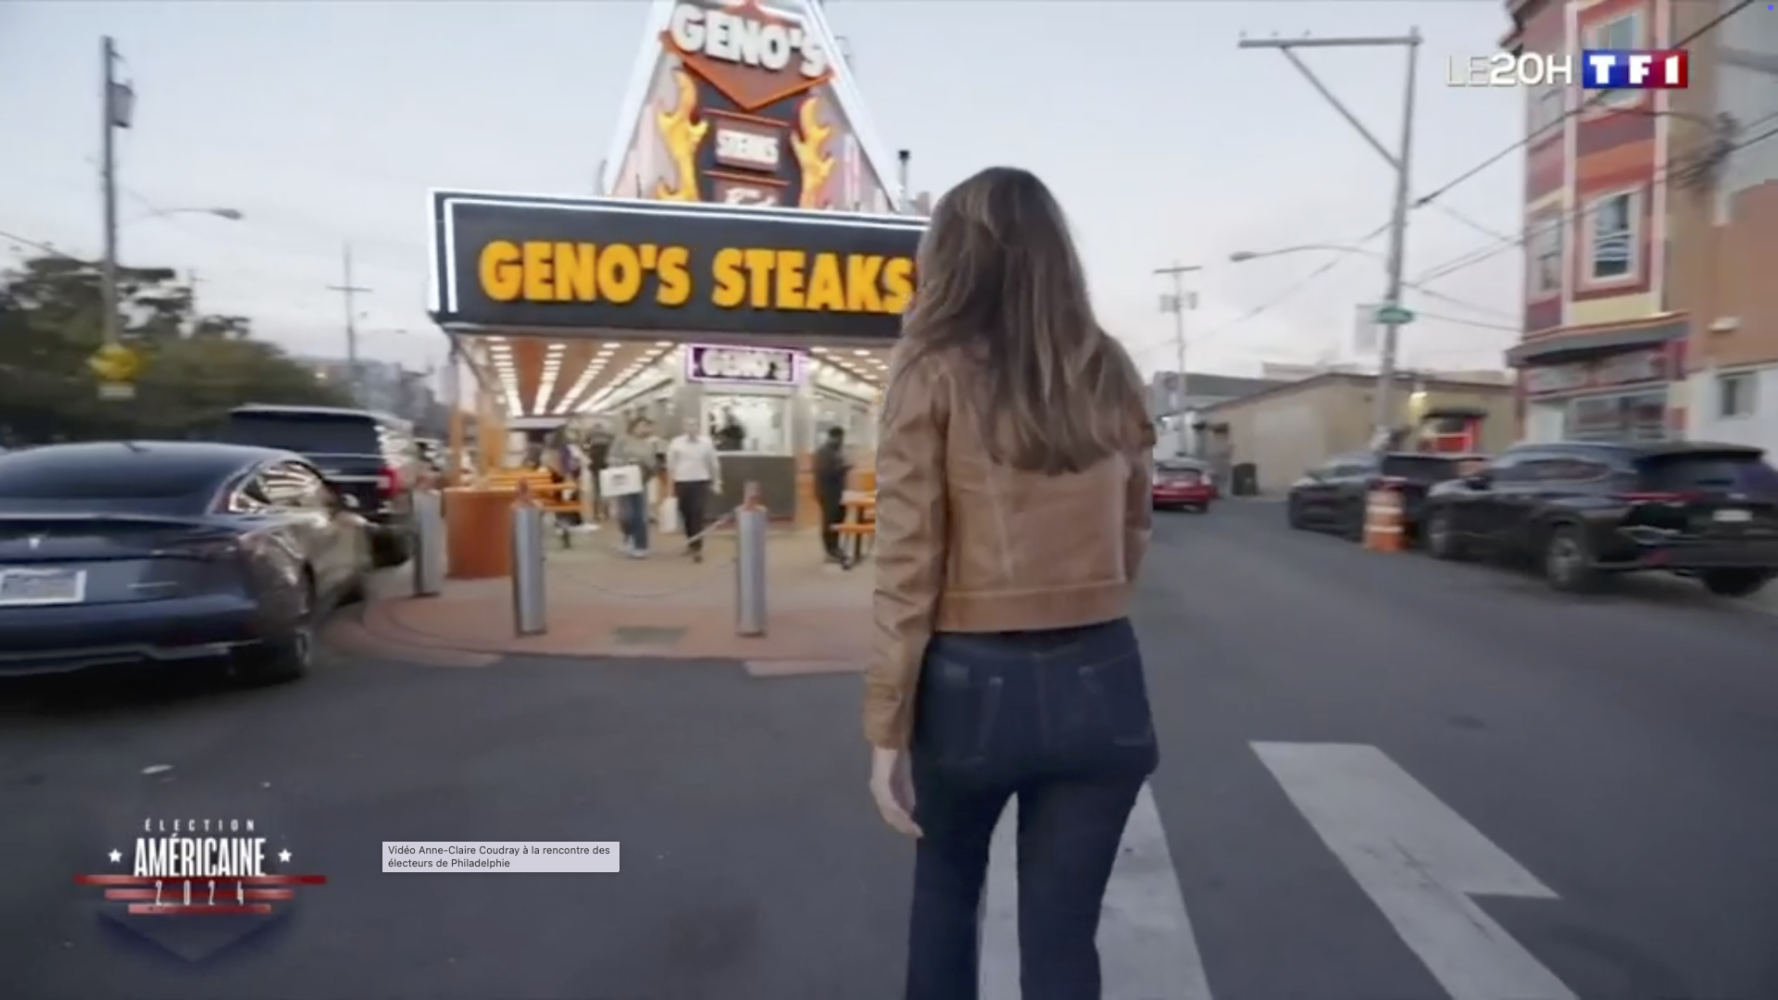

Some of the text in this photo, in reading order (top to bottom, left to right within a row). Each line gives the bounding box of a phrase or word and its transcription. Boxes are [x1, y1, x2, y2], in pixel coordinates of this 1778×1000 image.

[671, 3, 827, 78] GENO'S
[480, 241, 914, 314] GENO'S STEAKS
